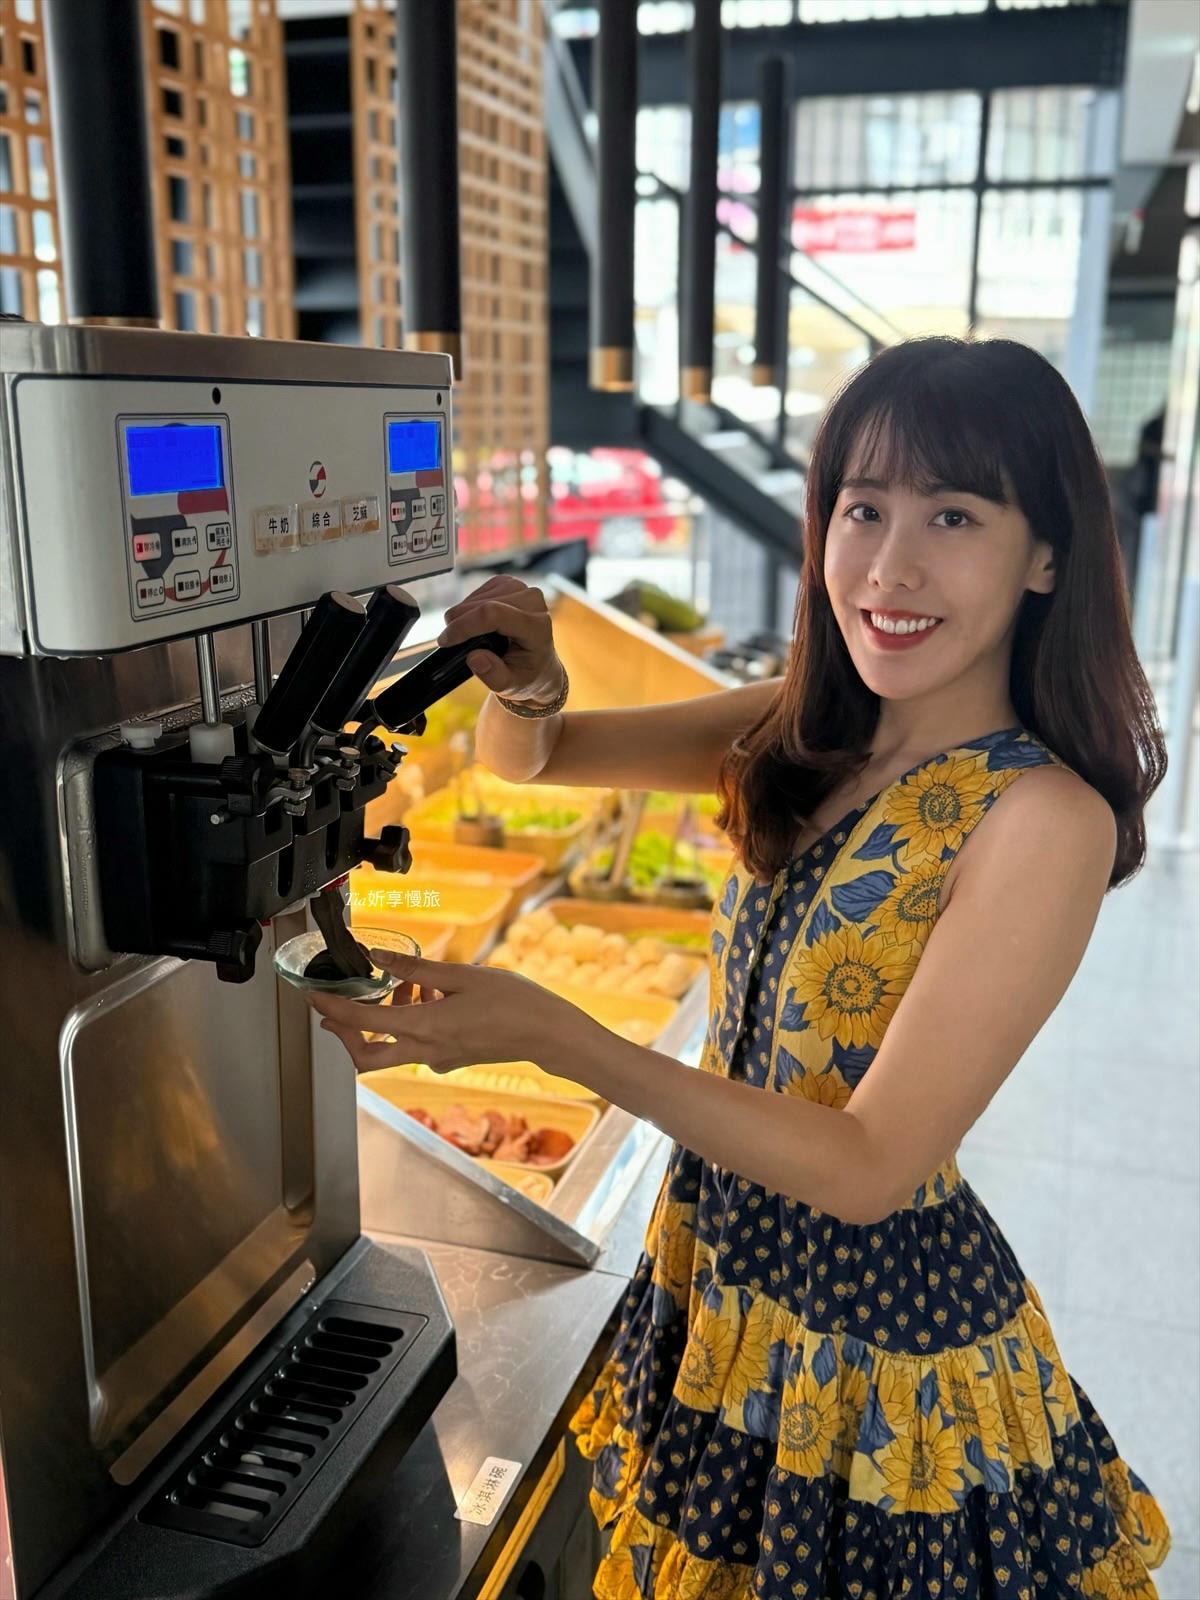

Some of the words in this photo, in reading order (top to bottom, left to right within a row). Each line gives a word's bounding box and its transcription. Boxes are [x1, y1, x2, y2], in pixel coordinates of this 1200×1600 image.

[268, 517, 289, 535] 牛奶
[469, 1465, 508, 1515] 冰淇淋碗
